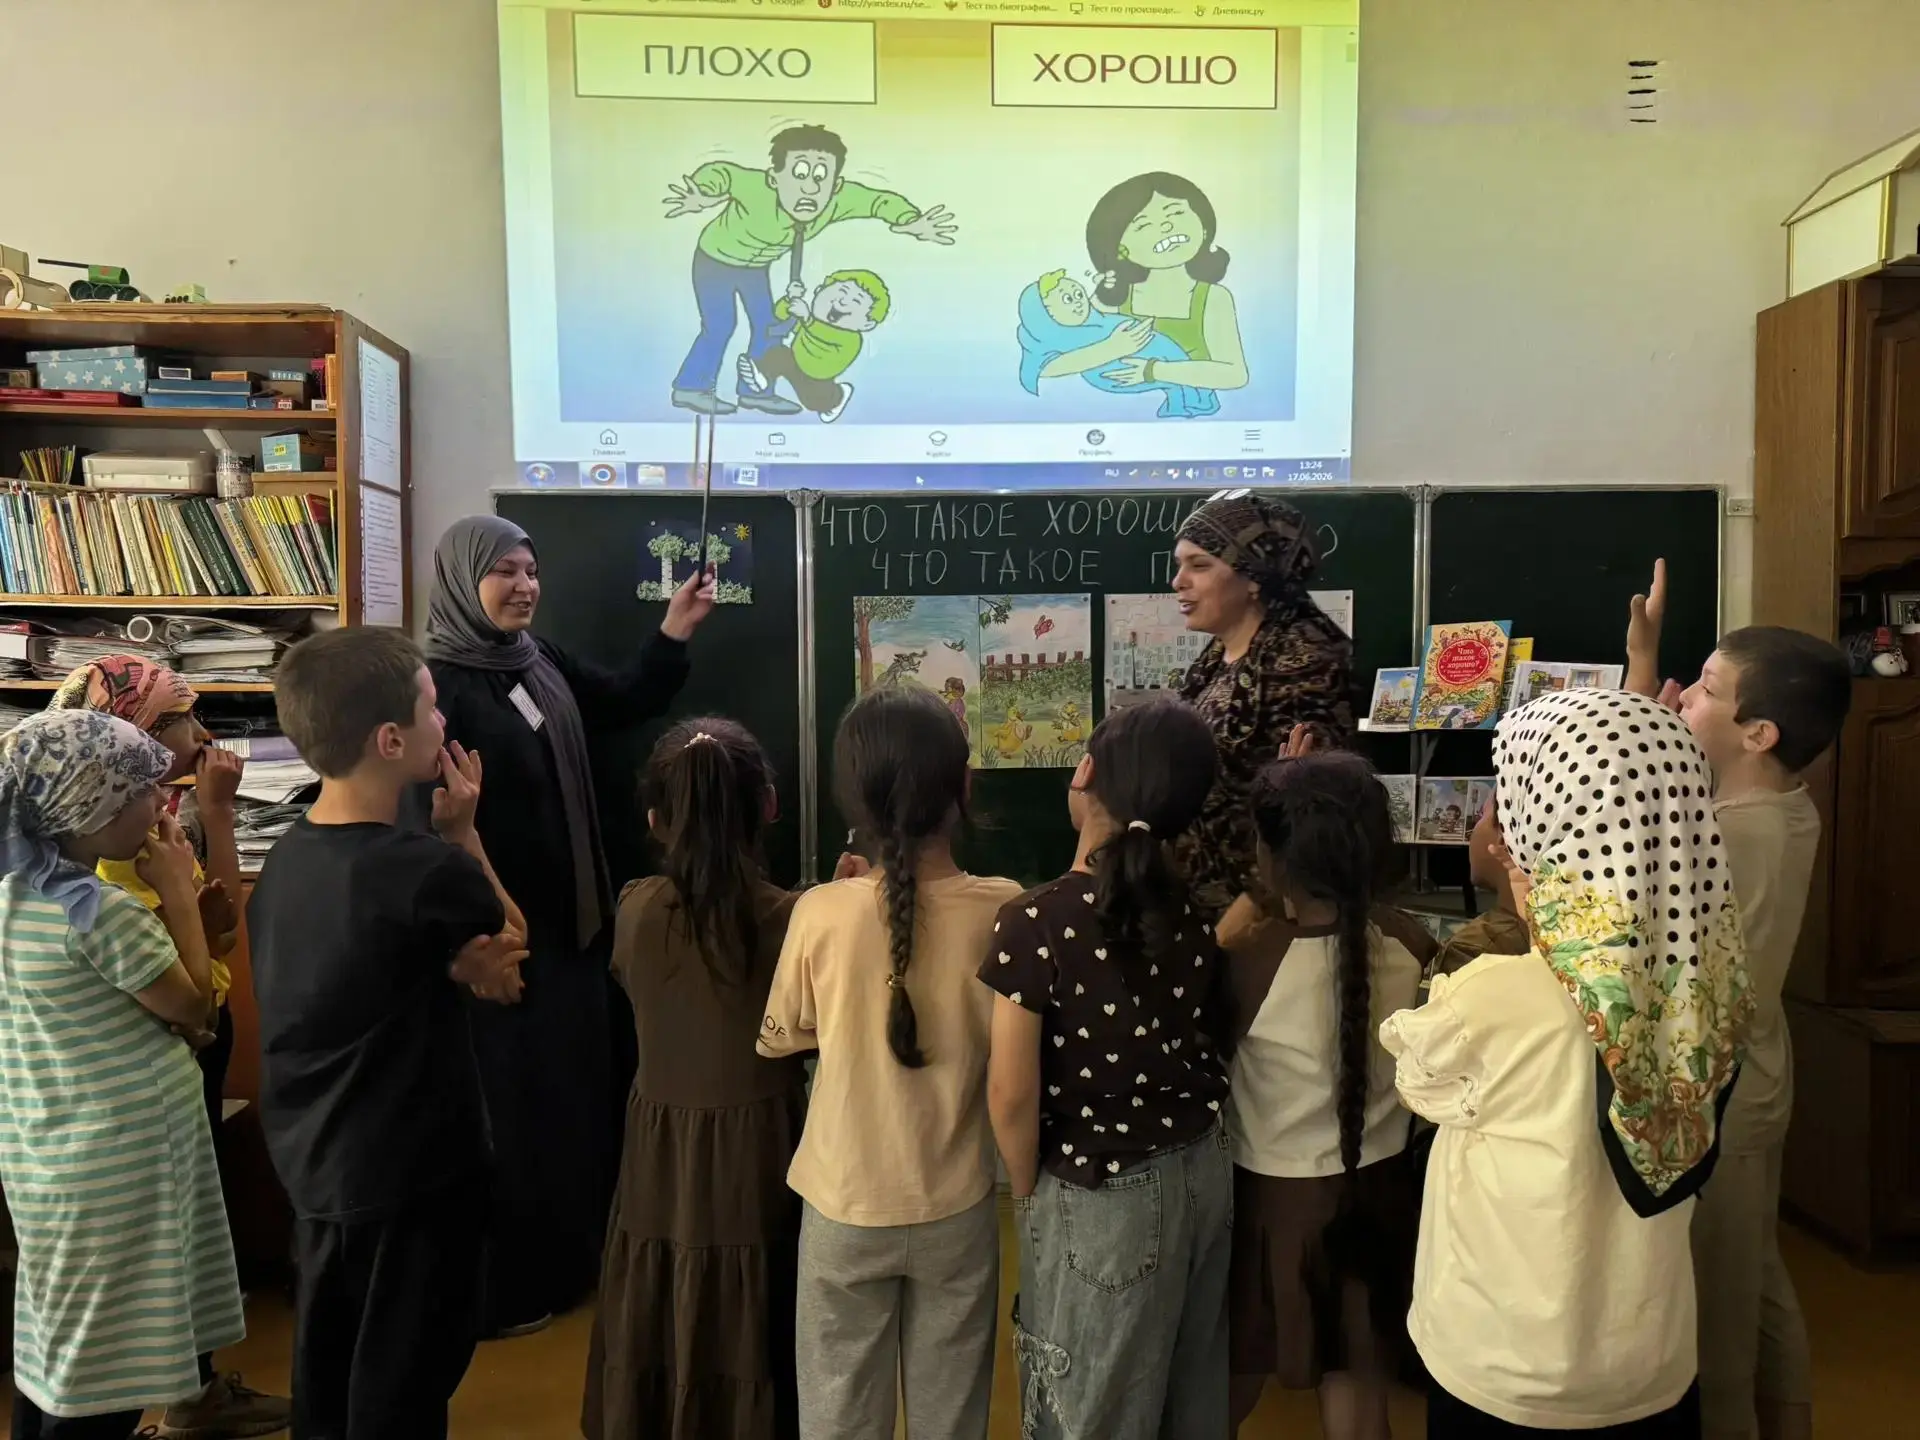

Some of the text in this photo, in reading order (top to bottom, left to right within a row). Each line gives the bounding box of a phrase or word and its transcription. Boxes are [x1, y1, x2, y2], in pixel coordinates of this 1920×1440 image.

[965, 2, 982, 10] Тест
[1090, 4, 1108, 12] Тест
[644, 45, 812, 79] ПЛОХО
[1033, 53, 1238, 85] ХОРОШО
[1300, 461, 1322, 470] 13:24
[1105, 468, 1120, 477] RU
[1288, 472, 1333, 481] 17.06.2026
[821, 497, 887, 546] ЧТО
[904, 500, 1017, 541] ТАКОЕ
[872, 548, 947, 590] ЧТО
[970, 547, 1102, 585] ТАКОЕ
